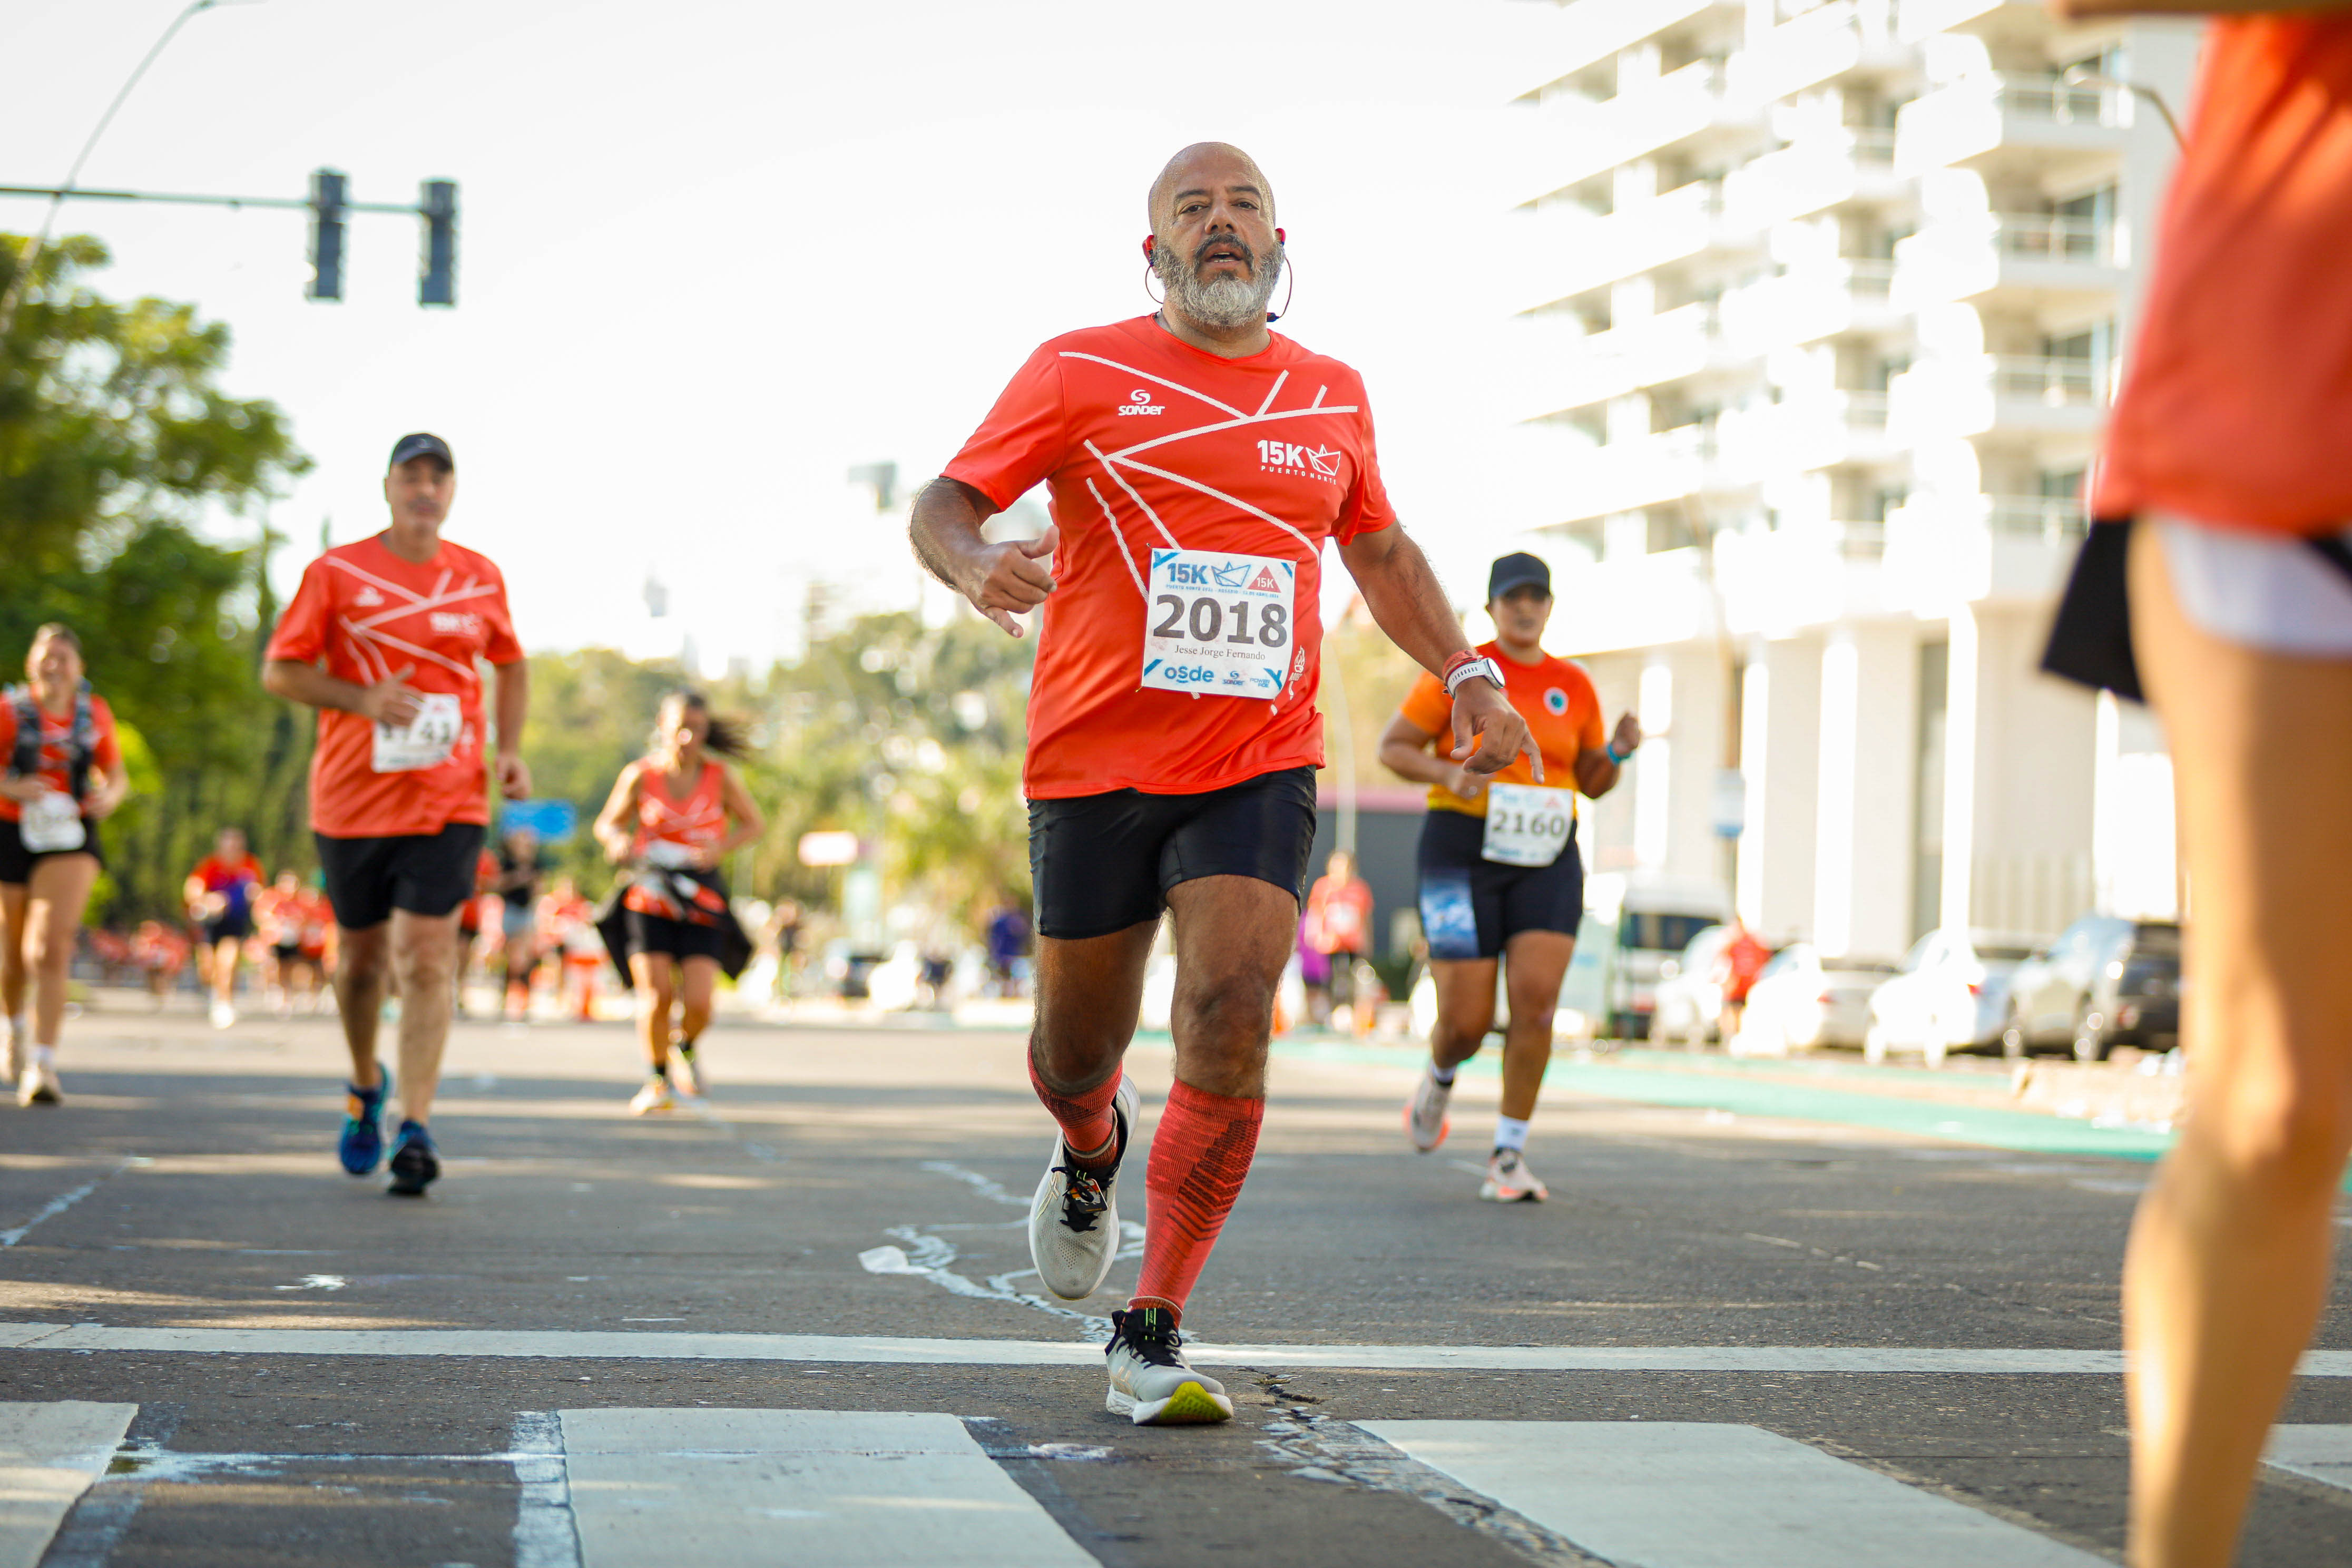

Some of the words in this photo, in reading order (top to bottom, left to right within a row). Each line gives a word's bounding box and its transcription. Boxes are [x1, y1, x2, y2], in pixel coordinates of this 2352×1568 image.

[1257, 439, 1305, 468] 15K
[1261, 465, 1306, 476] PUERTO
[1310, 473, 1337, 485] NORTE
[1167, 563, 1209, 584] 15K
[1257, 577, 1274, 589] 15K
[1153, 594, 1287, 648] 2018
[1174, 645, 1197, 654] Jesse
[1200, 646, 1223, 658] Jorge
[1227, 649, 1265, 660] Fernando
[1164, 665, 1214, 683] osde
[1492, 809, 1565, 838] 2160
